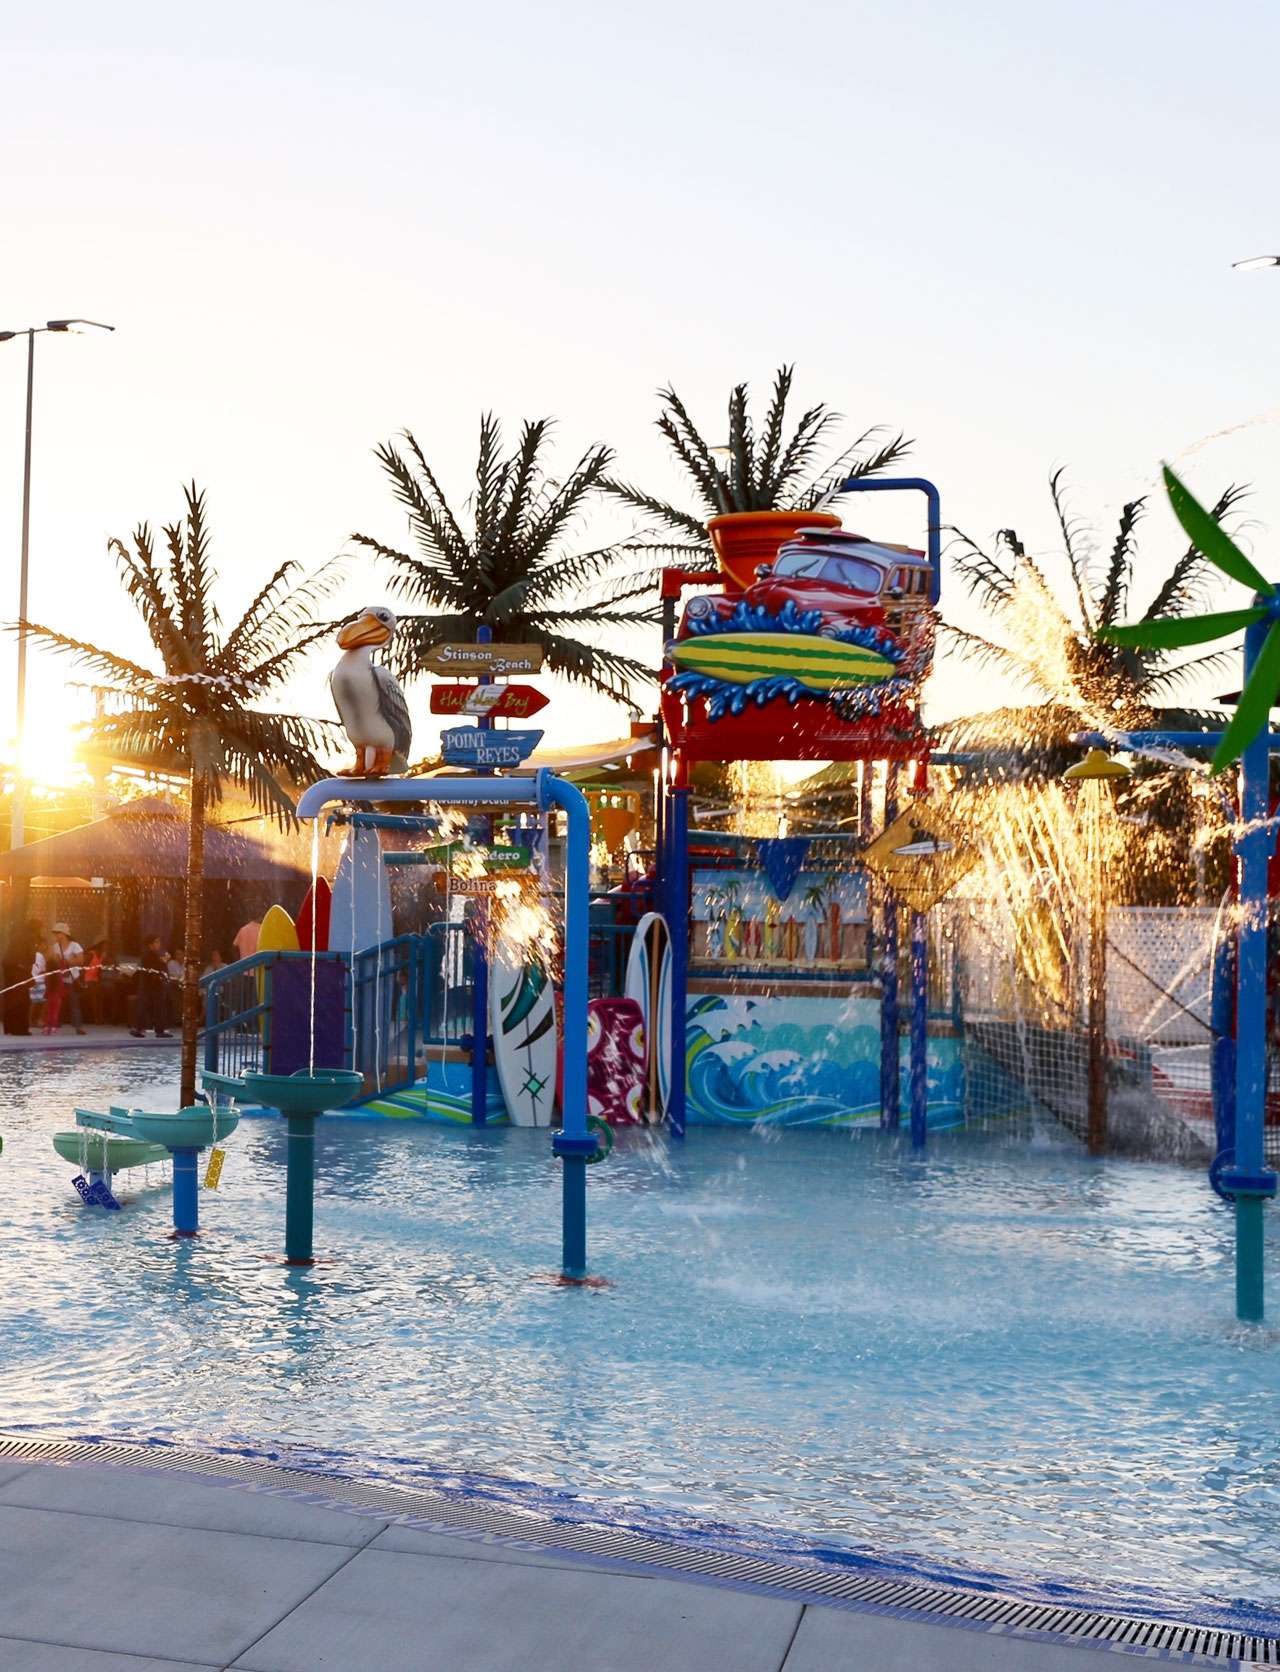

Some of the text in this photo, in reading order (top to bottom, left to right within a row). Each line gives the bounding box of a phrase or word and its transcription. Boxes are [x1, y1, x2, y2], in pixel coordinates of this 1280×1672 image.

[437, 646, 492, 661] Stinson
[490, 659, 531, 672] Beach
[504, 693, 530, 715] Bay
[447, 733, 486, 749] POINT
[477, 748, 520, 763] REYES
[450, 878, 497, 892] Bolina
